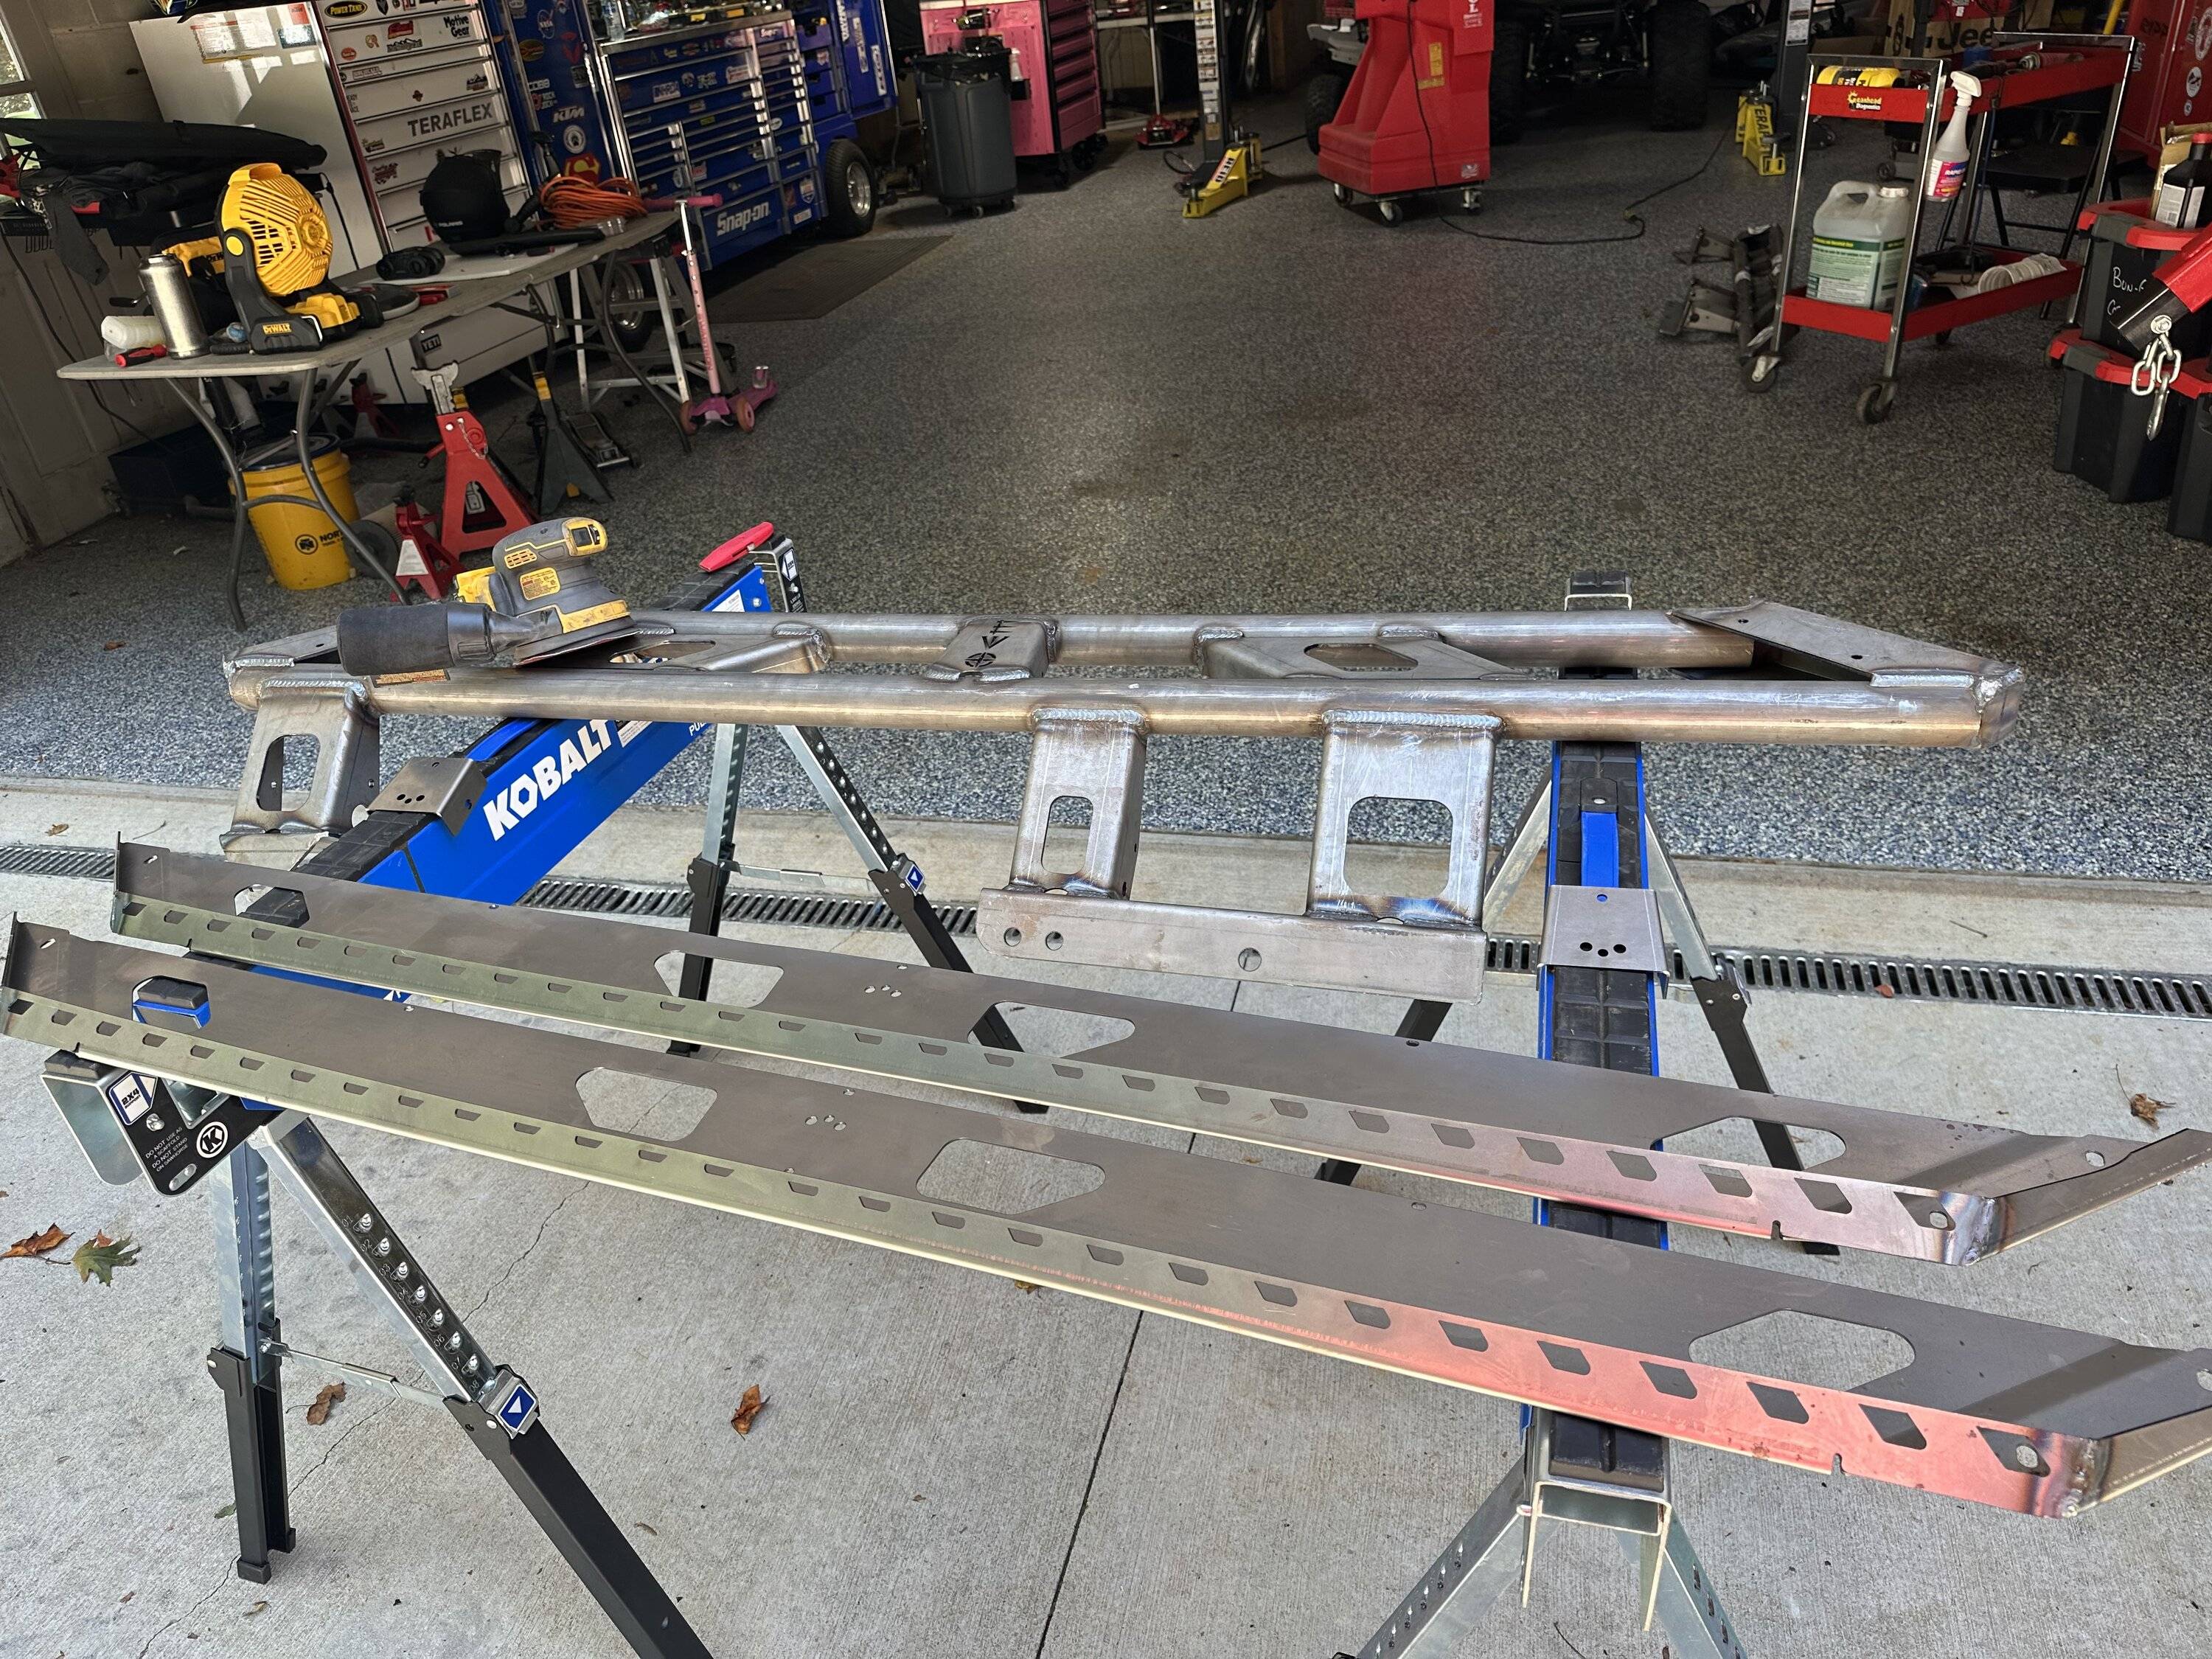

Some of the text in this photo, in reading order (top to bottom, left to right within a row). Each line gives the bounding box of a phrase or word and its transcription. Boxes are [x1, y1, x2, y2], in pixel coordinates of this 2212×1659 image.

[444, 13, 469, 28] Motive
[451, 27, 470, 38] Gear
[408, 102, 493, 137] TERAFLEX
[553, 106, 585, 124] KTM
[717, 201, 771, 237] Snap-on
[421, 335, 442, 352] YETI
[483, 719, 612, 841] KOBALT
[121, 1088, 140, 1106] 2X4
[124, 1094, 142, 1109] SUPPORT
[145, 1127, 184, 1159] DO NOT USE AS
[152, 1137, 188, 1169] DO NOT STAND
[158, 1135, 181, 1156] SCAFFOLD
[156, 1144, 189, 1172] ON SAWHORSE
